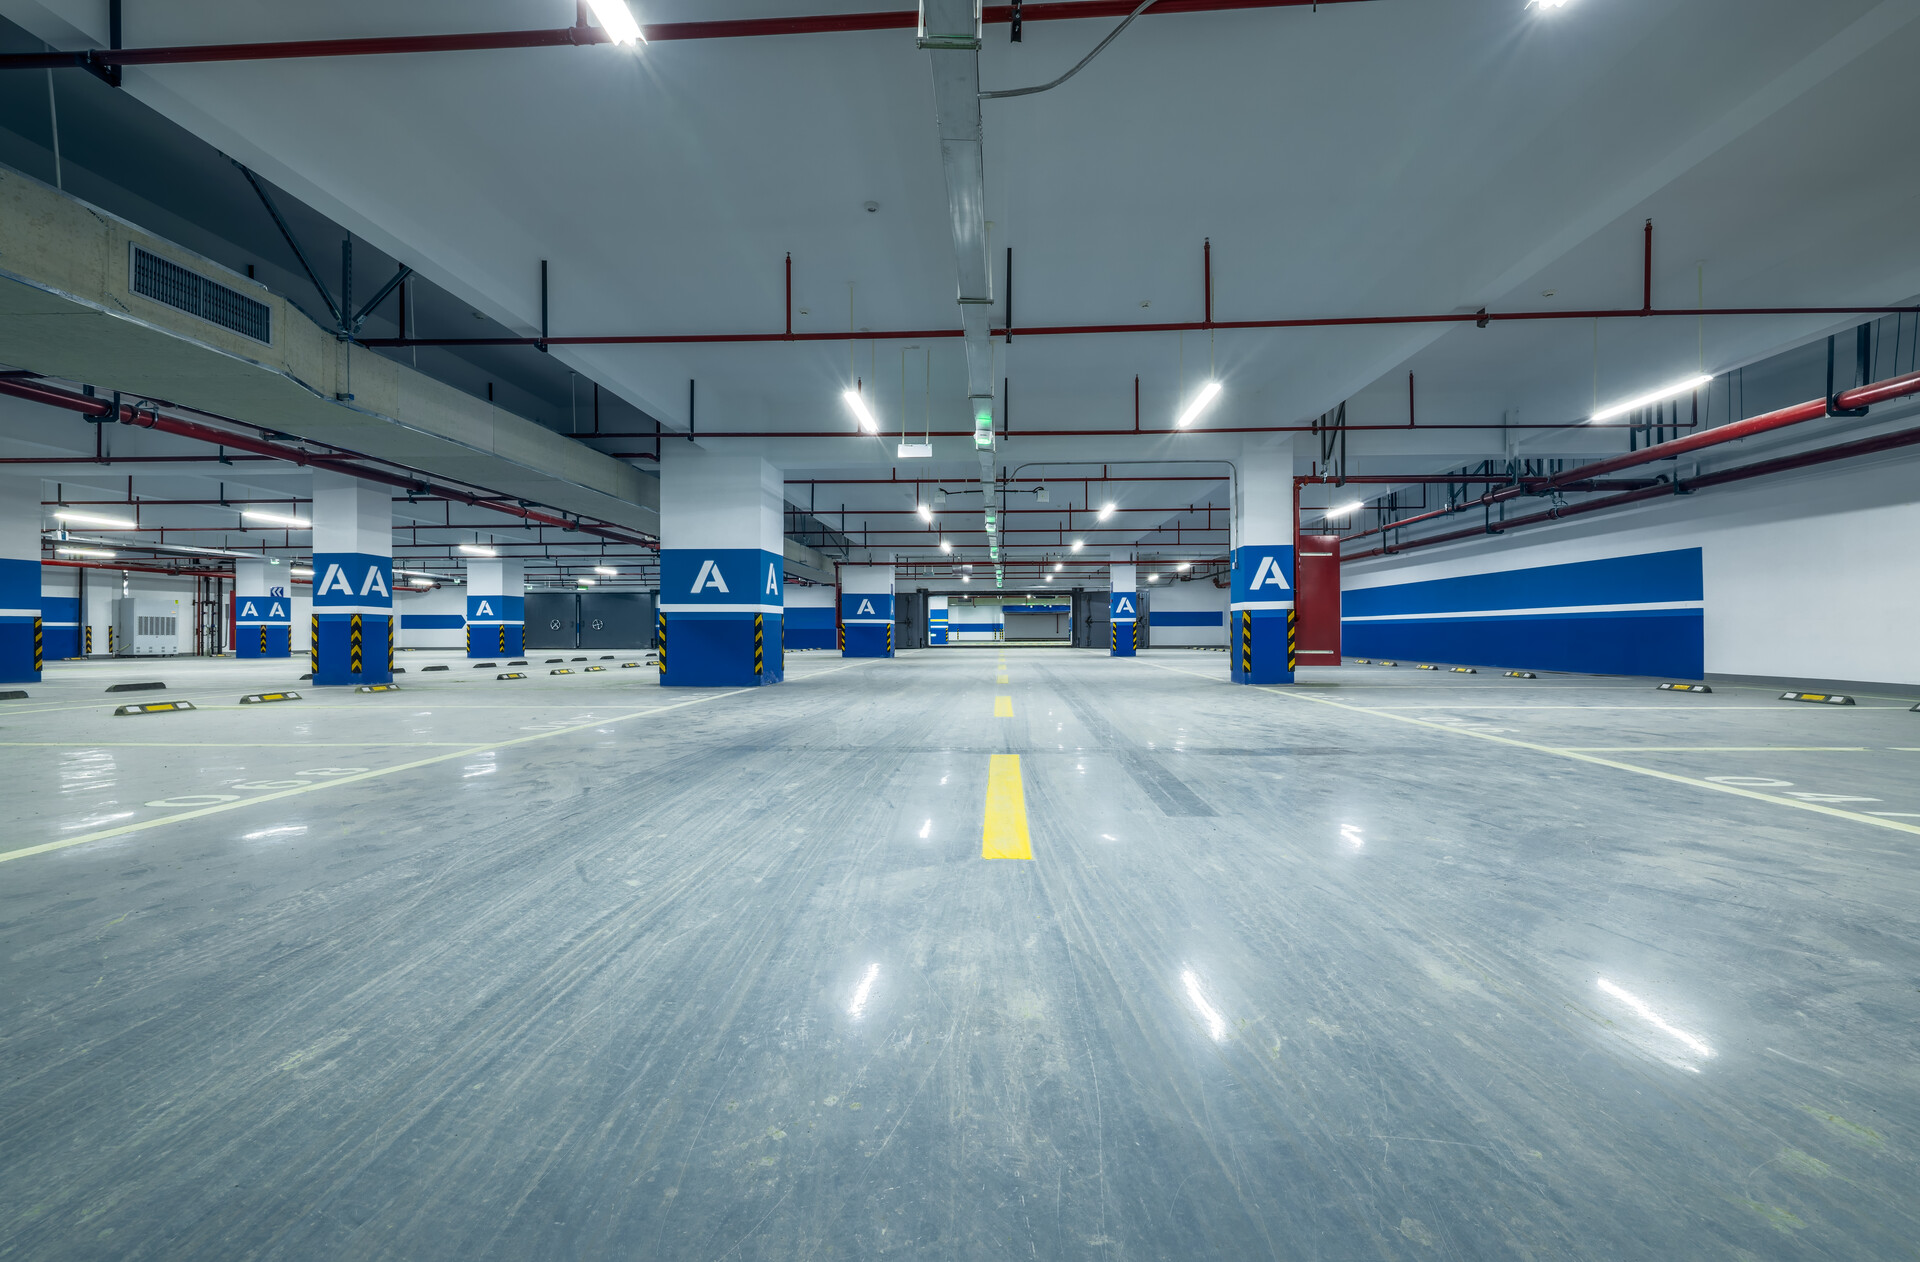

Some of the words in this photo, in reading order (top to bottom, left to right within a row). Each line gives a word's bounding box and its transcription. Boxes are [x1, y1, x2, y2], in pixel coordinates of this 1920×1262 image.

[317, 564, 354, 595] A
[359, 566, 390, 597] A
[690, 560, 729, 593] A
[766, 562, 778, 595] A
[1249, 556, 1290, 590] A
[241, 601, 259, 617] A
[269, 602, 285, 618] A
[476, 600, 493, 616] A
[856, 598, 876, 614] A
[1115, 597, 1135, 613] A
[144, 767, 371, 807] 068
